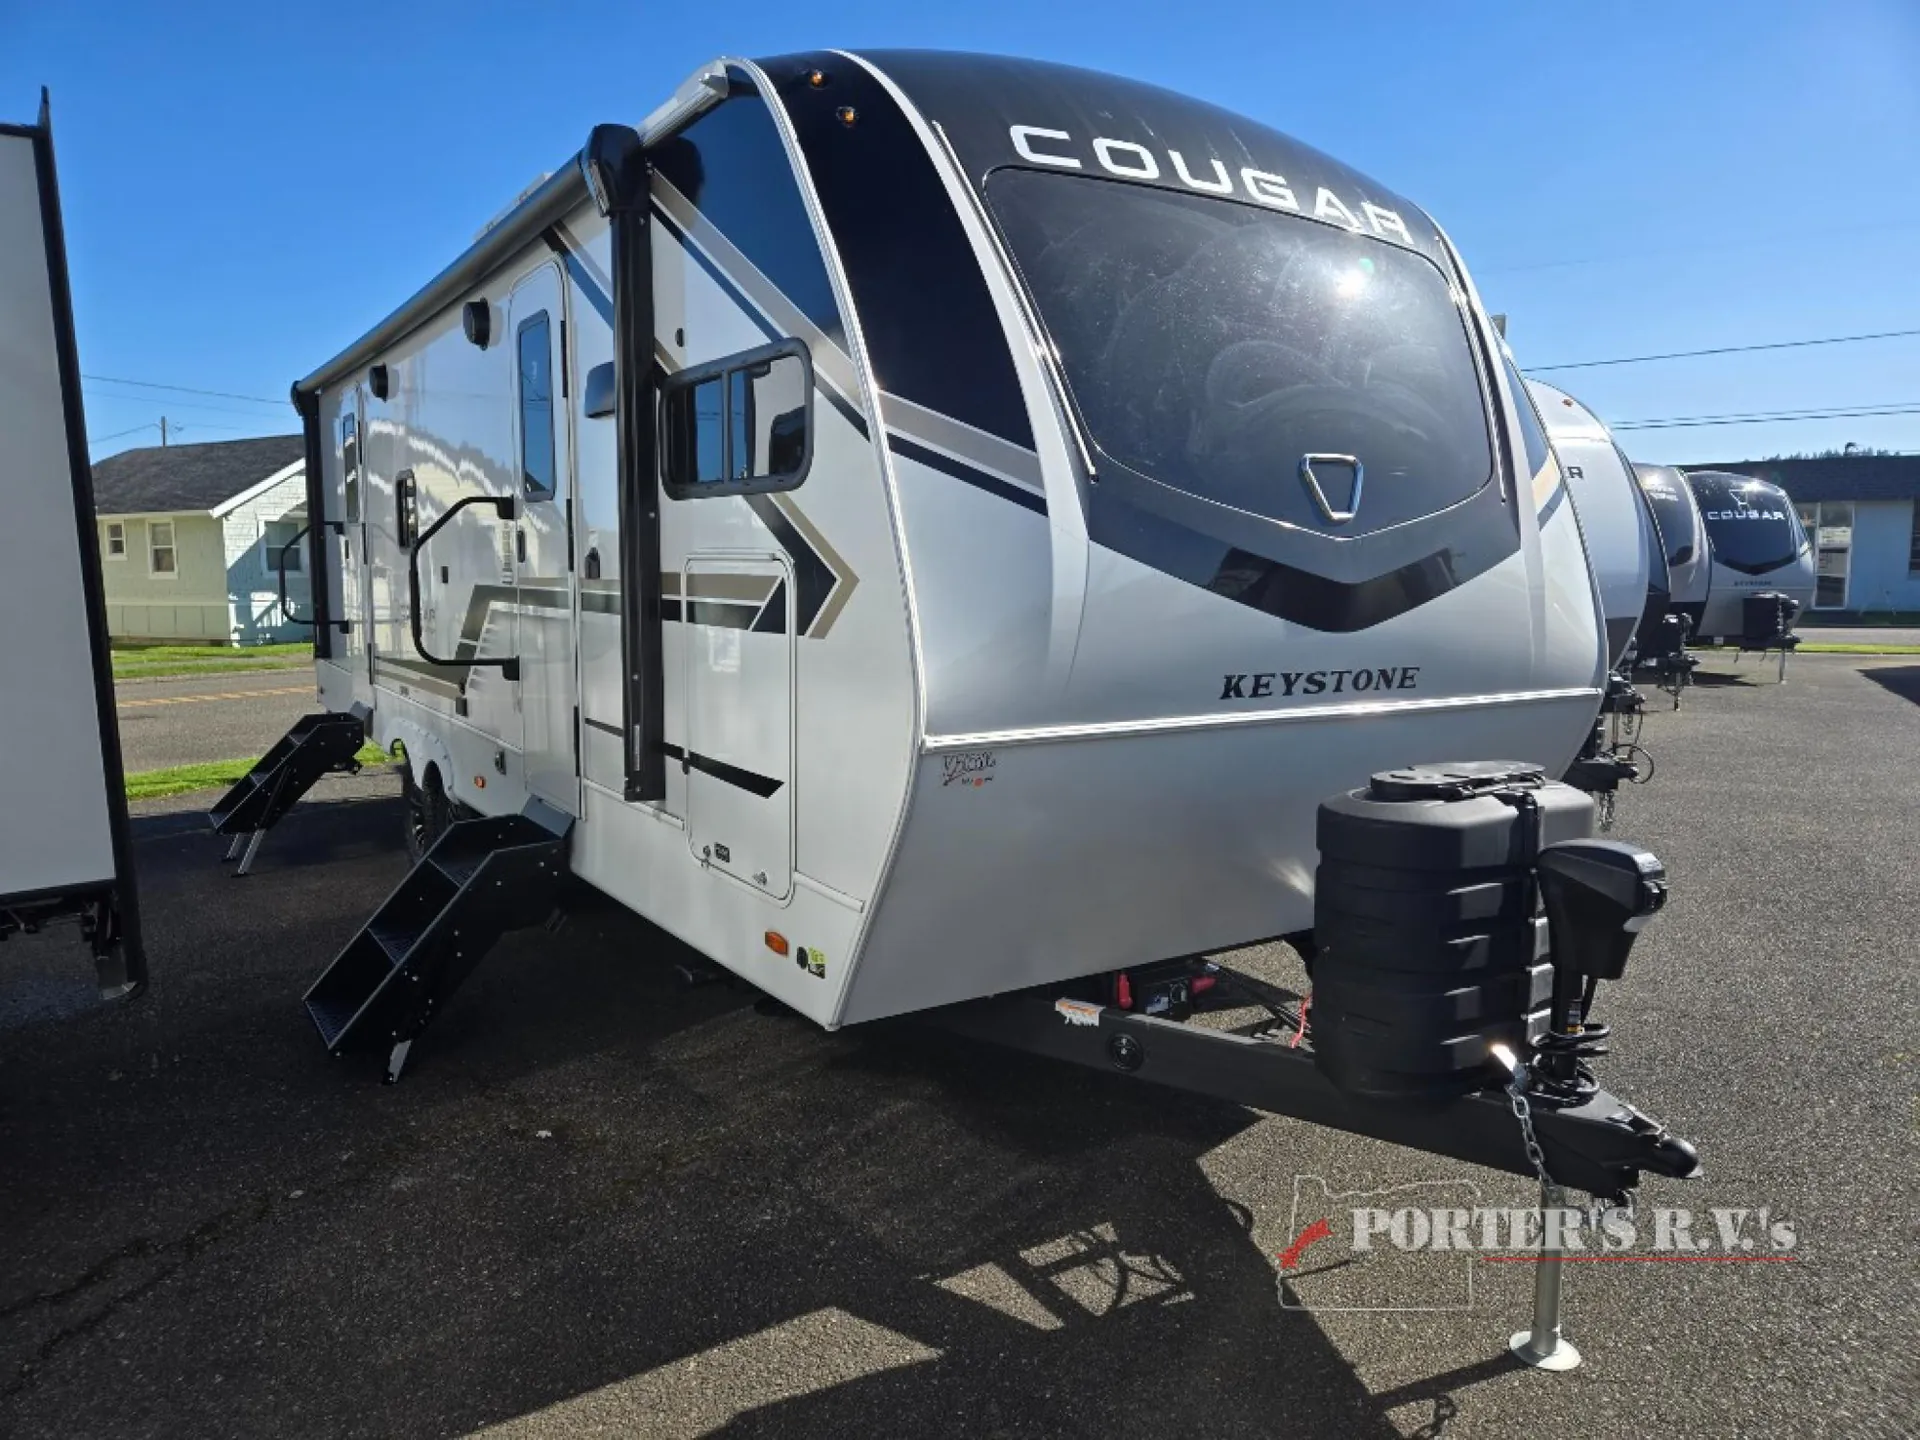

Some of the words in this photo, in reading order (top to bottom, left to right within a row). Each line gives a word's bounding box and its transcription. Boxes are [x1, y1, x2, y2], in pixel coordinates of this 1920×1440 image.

[1010, 124, 1413, 245] COUGAR
[1707, 510, 1786, 520] COUGAR
[1220, 667, 1420, 700] KEYSTONE
